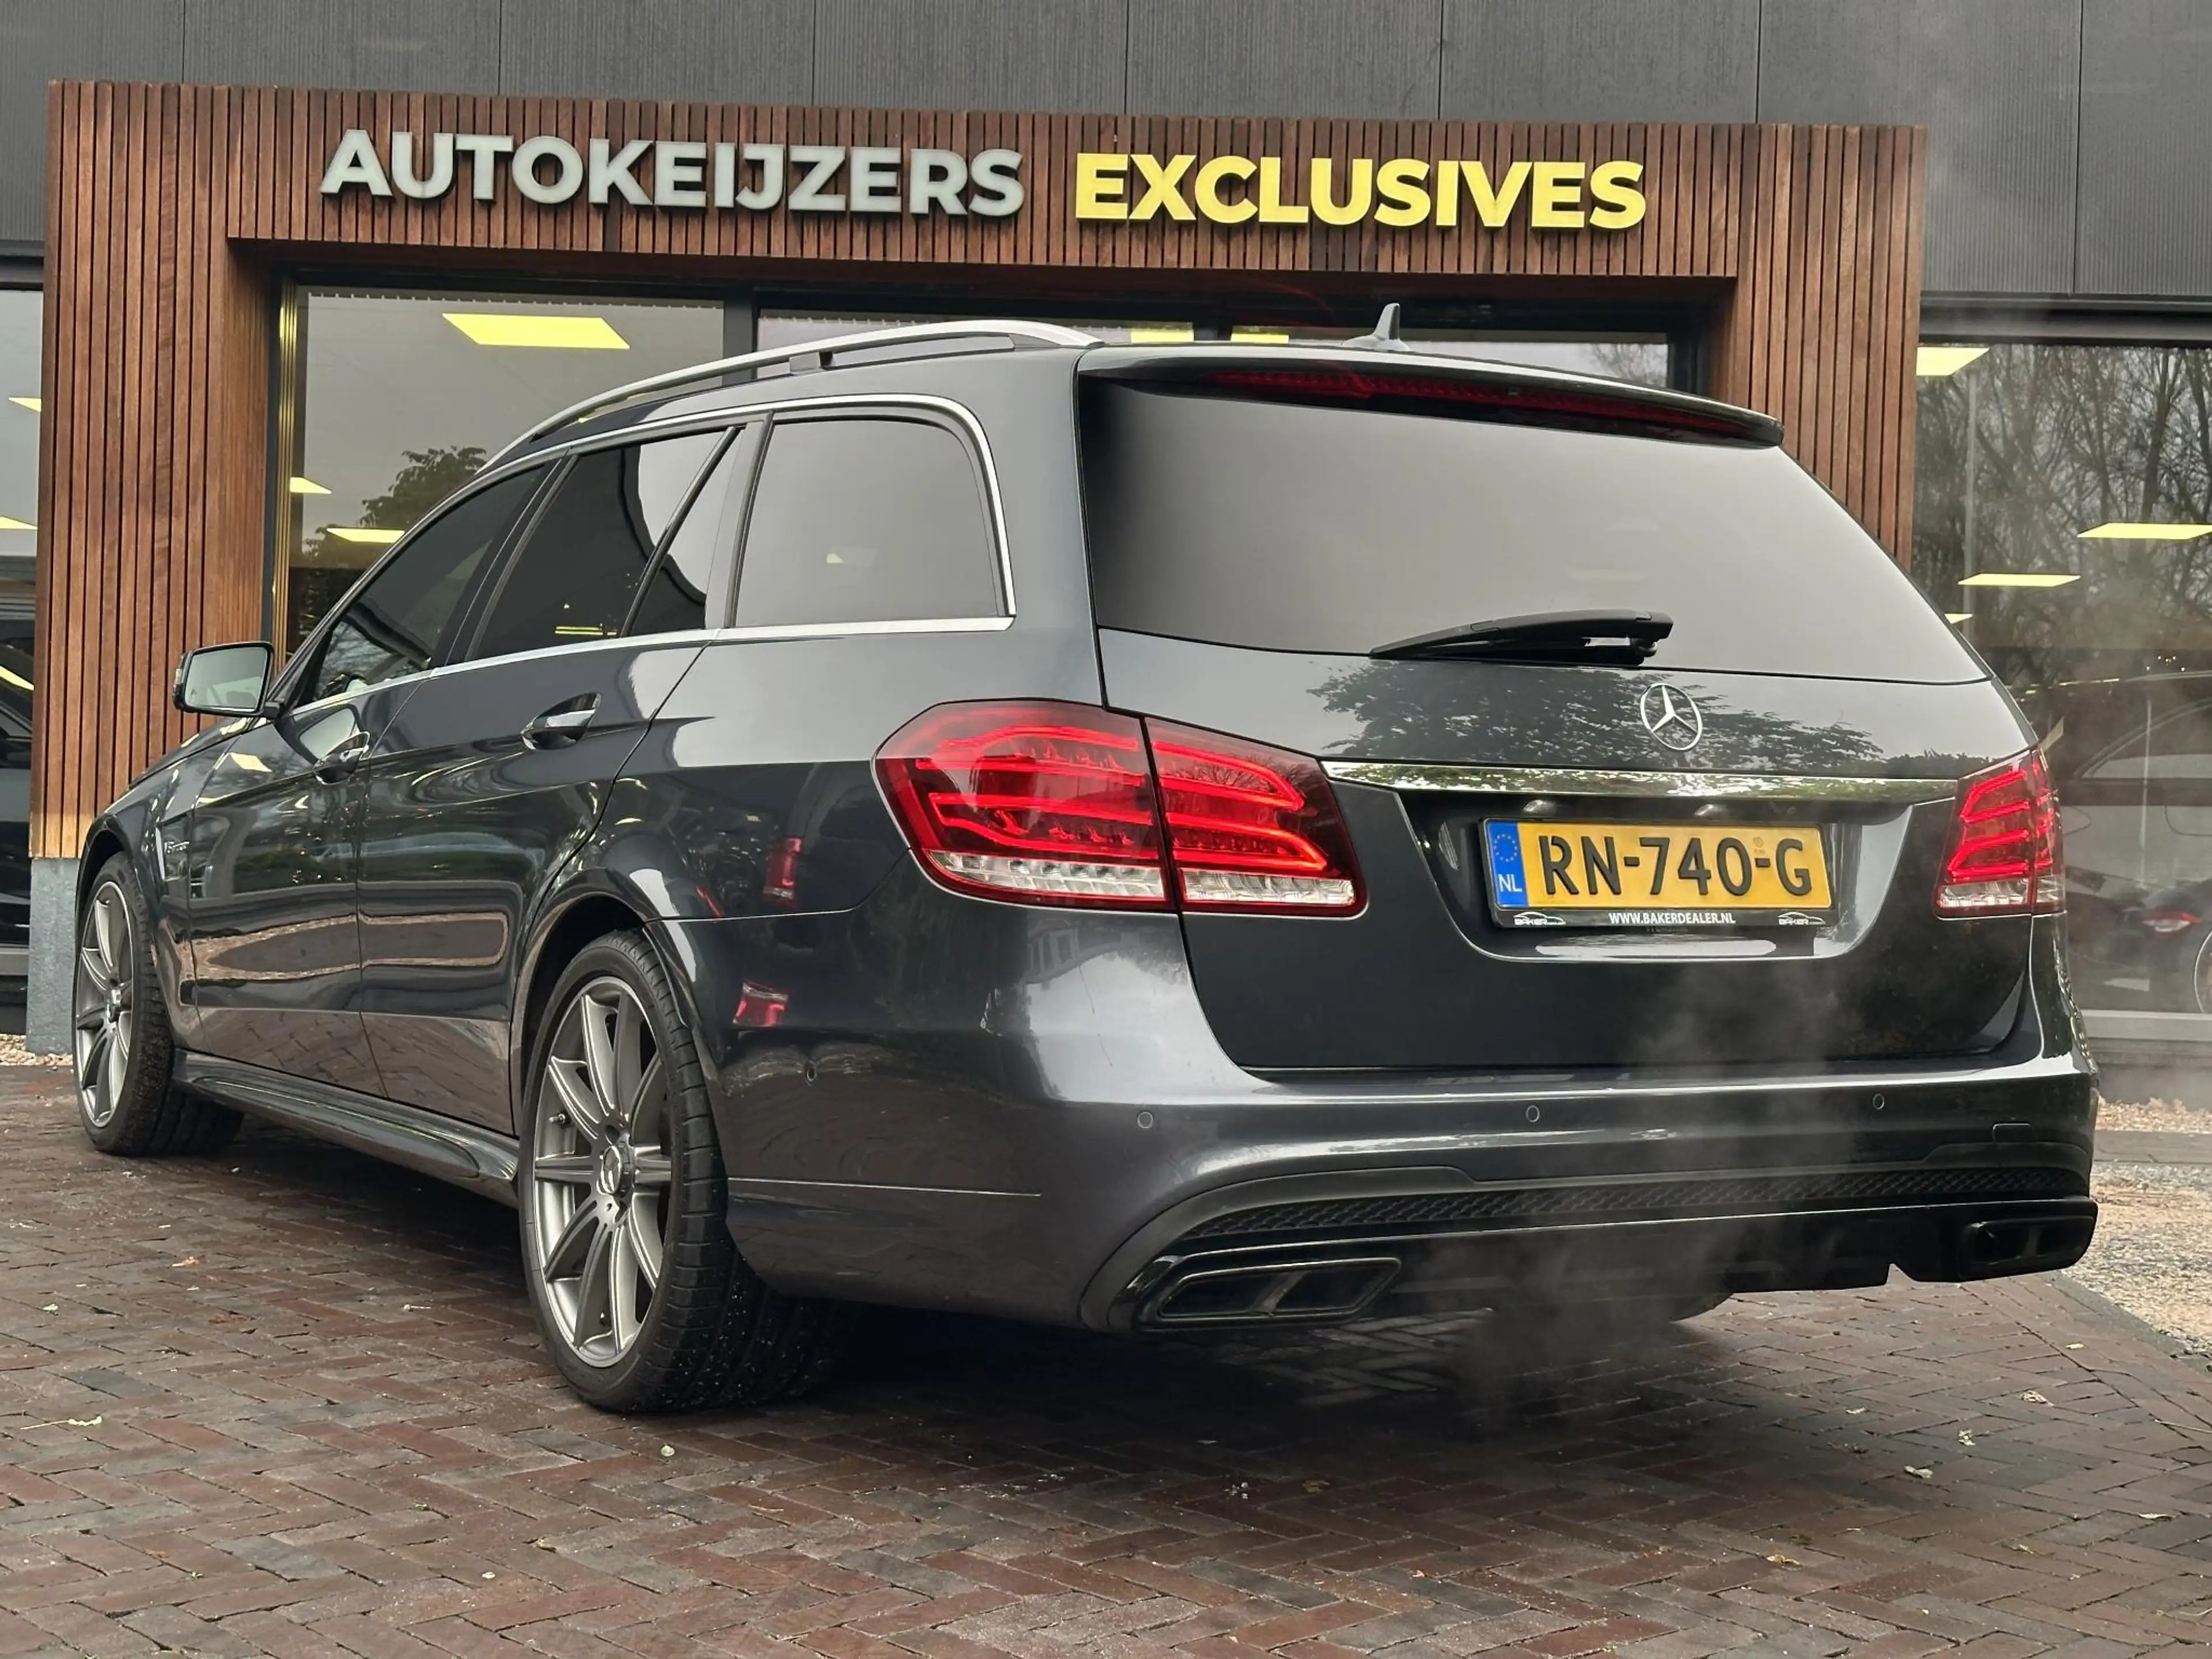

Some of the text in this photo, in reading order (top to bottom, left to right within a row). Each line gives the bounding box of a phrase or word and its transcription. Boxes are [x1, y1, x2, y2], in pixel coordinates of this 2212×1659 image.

[319, 128, 1647, 230] AUTOKEIJZERS EXCLUSIVES
[1498, 873, 1522, 893] NL
[1539, 835, 1813, 896] RN-740-G
[1608, 912, 1737, 925] WWW.BAKERDEALER.NL
